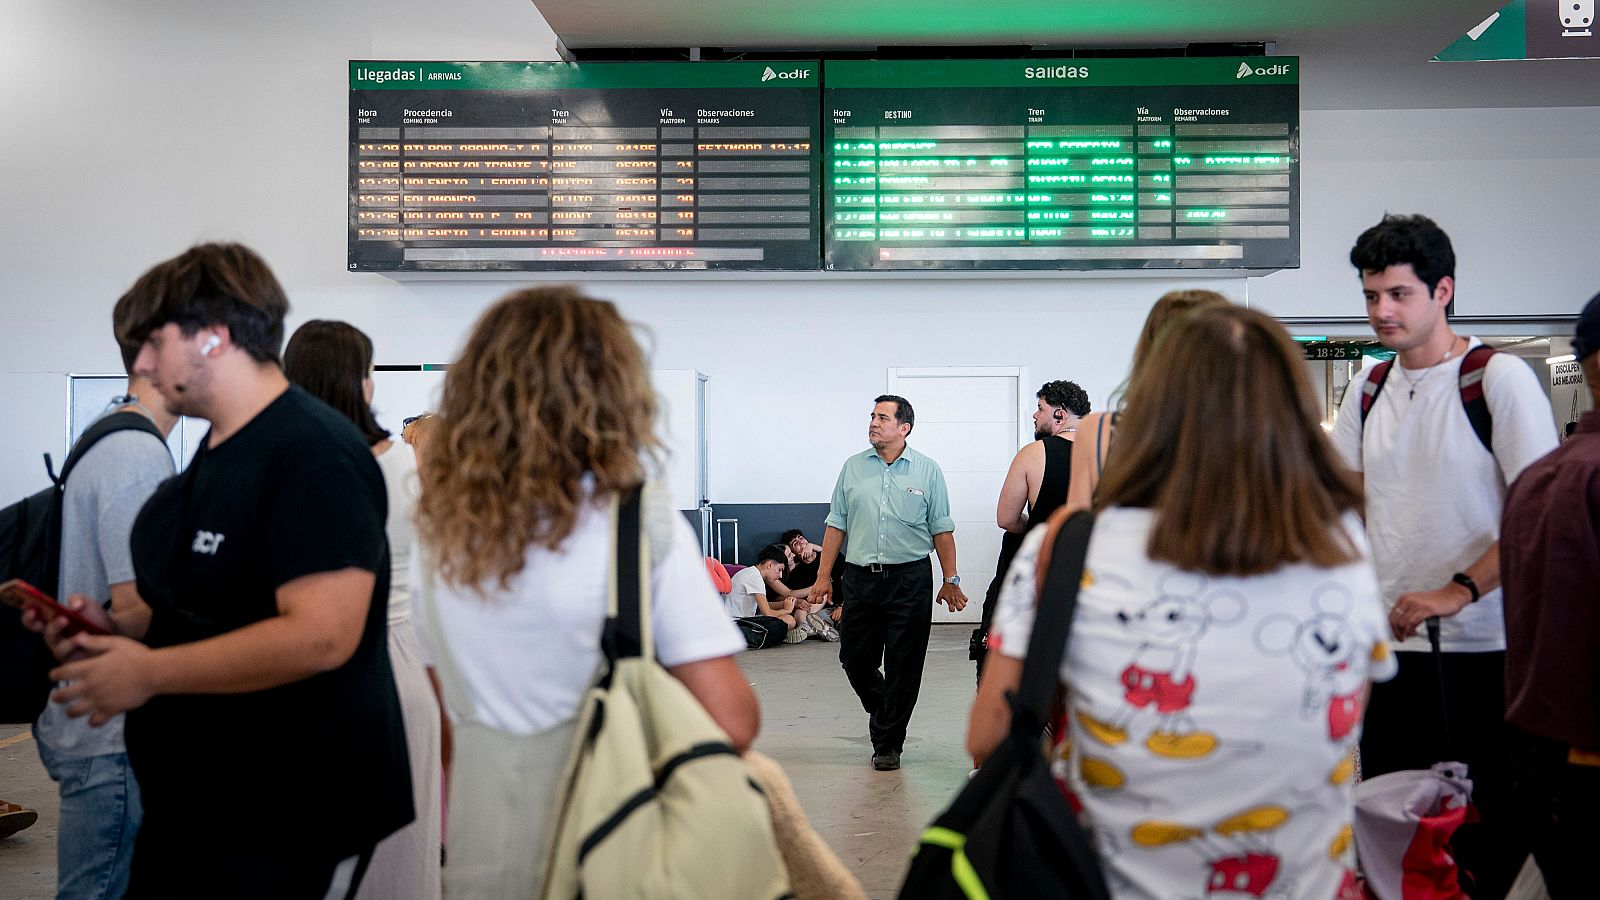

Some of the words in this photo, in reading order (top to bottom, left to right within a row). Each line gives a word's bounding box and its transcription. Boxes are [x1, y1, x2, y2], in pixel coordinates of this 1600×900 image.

[778, 69, 811, 80] adif
[1024, 65, 1089, 79] salidas
[1255, 64, 1290, 76] adif
[357, 68, 416, 83] Llegadas
[428, 72, 462, 80] ARRIVALS
[358, 109, 377, 117] Hora
[404, 109, 453, 117] Procedencia
[552, 109, 569, 117] Tren
[660, 108, 673, 117] Vía
[697, 108, 755, 117] Observaciones
[833, 109, 851, 117] Hora
[884, 110, 912, 119] DESTINO
[1028, 108, 1045, 116] Tren
[1137, 106, 1149, 115] Vía
[1174, 107, 1230, 116] Observaciones
[1316, 348, 1346, 358] 18:25
[1555, 363, 1580, 374] DISCULPEN
[1552, 376, 1562, 386] LAS
[1562, 374, 1584, 386] MEJORAS
